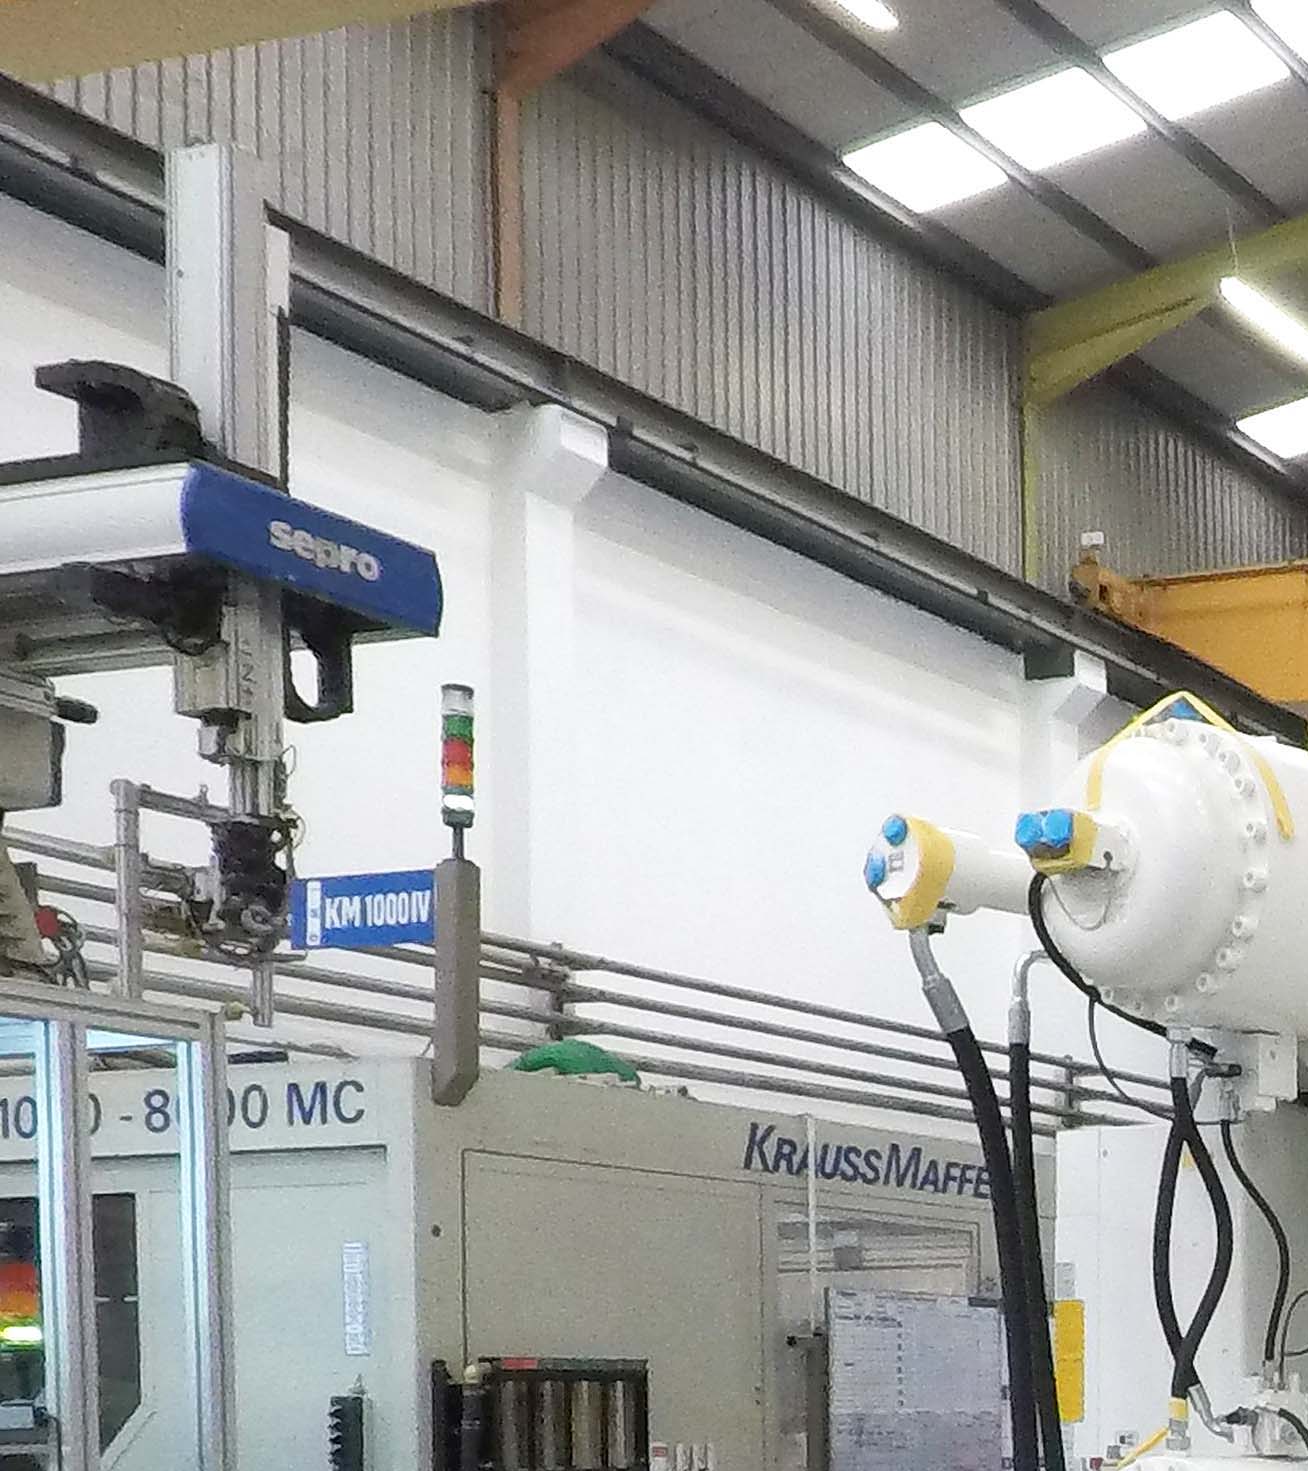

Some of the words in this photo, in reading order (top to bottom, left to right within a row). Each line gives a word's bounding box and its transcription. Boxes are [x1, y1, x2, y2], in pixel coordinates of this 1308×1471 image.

[269, 520, 379, 582] sepro
[324, 895, 362, 929] KM
[286, 1079, 366, 1127] MC
